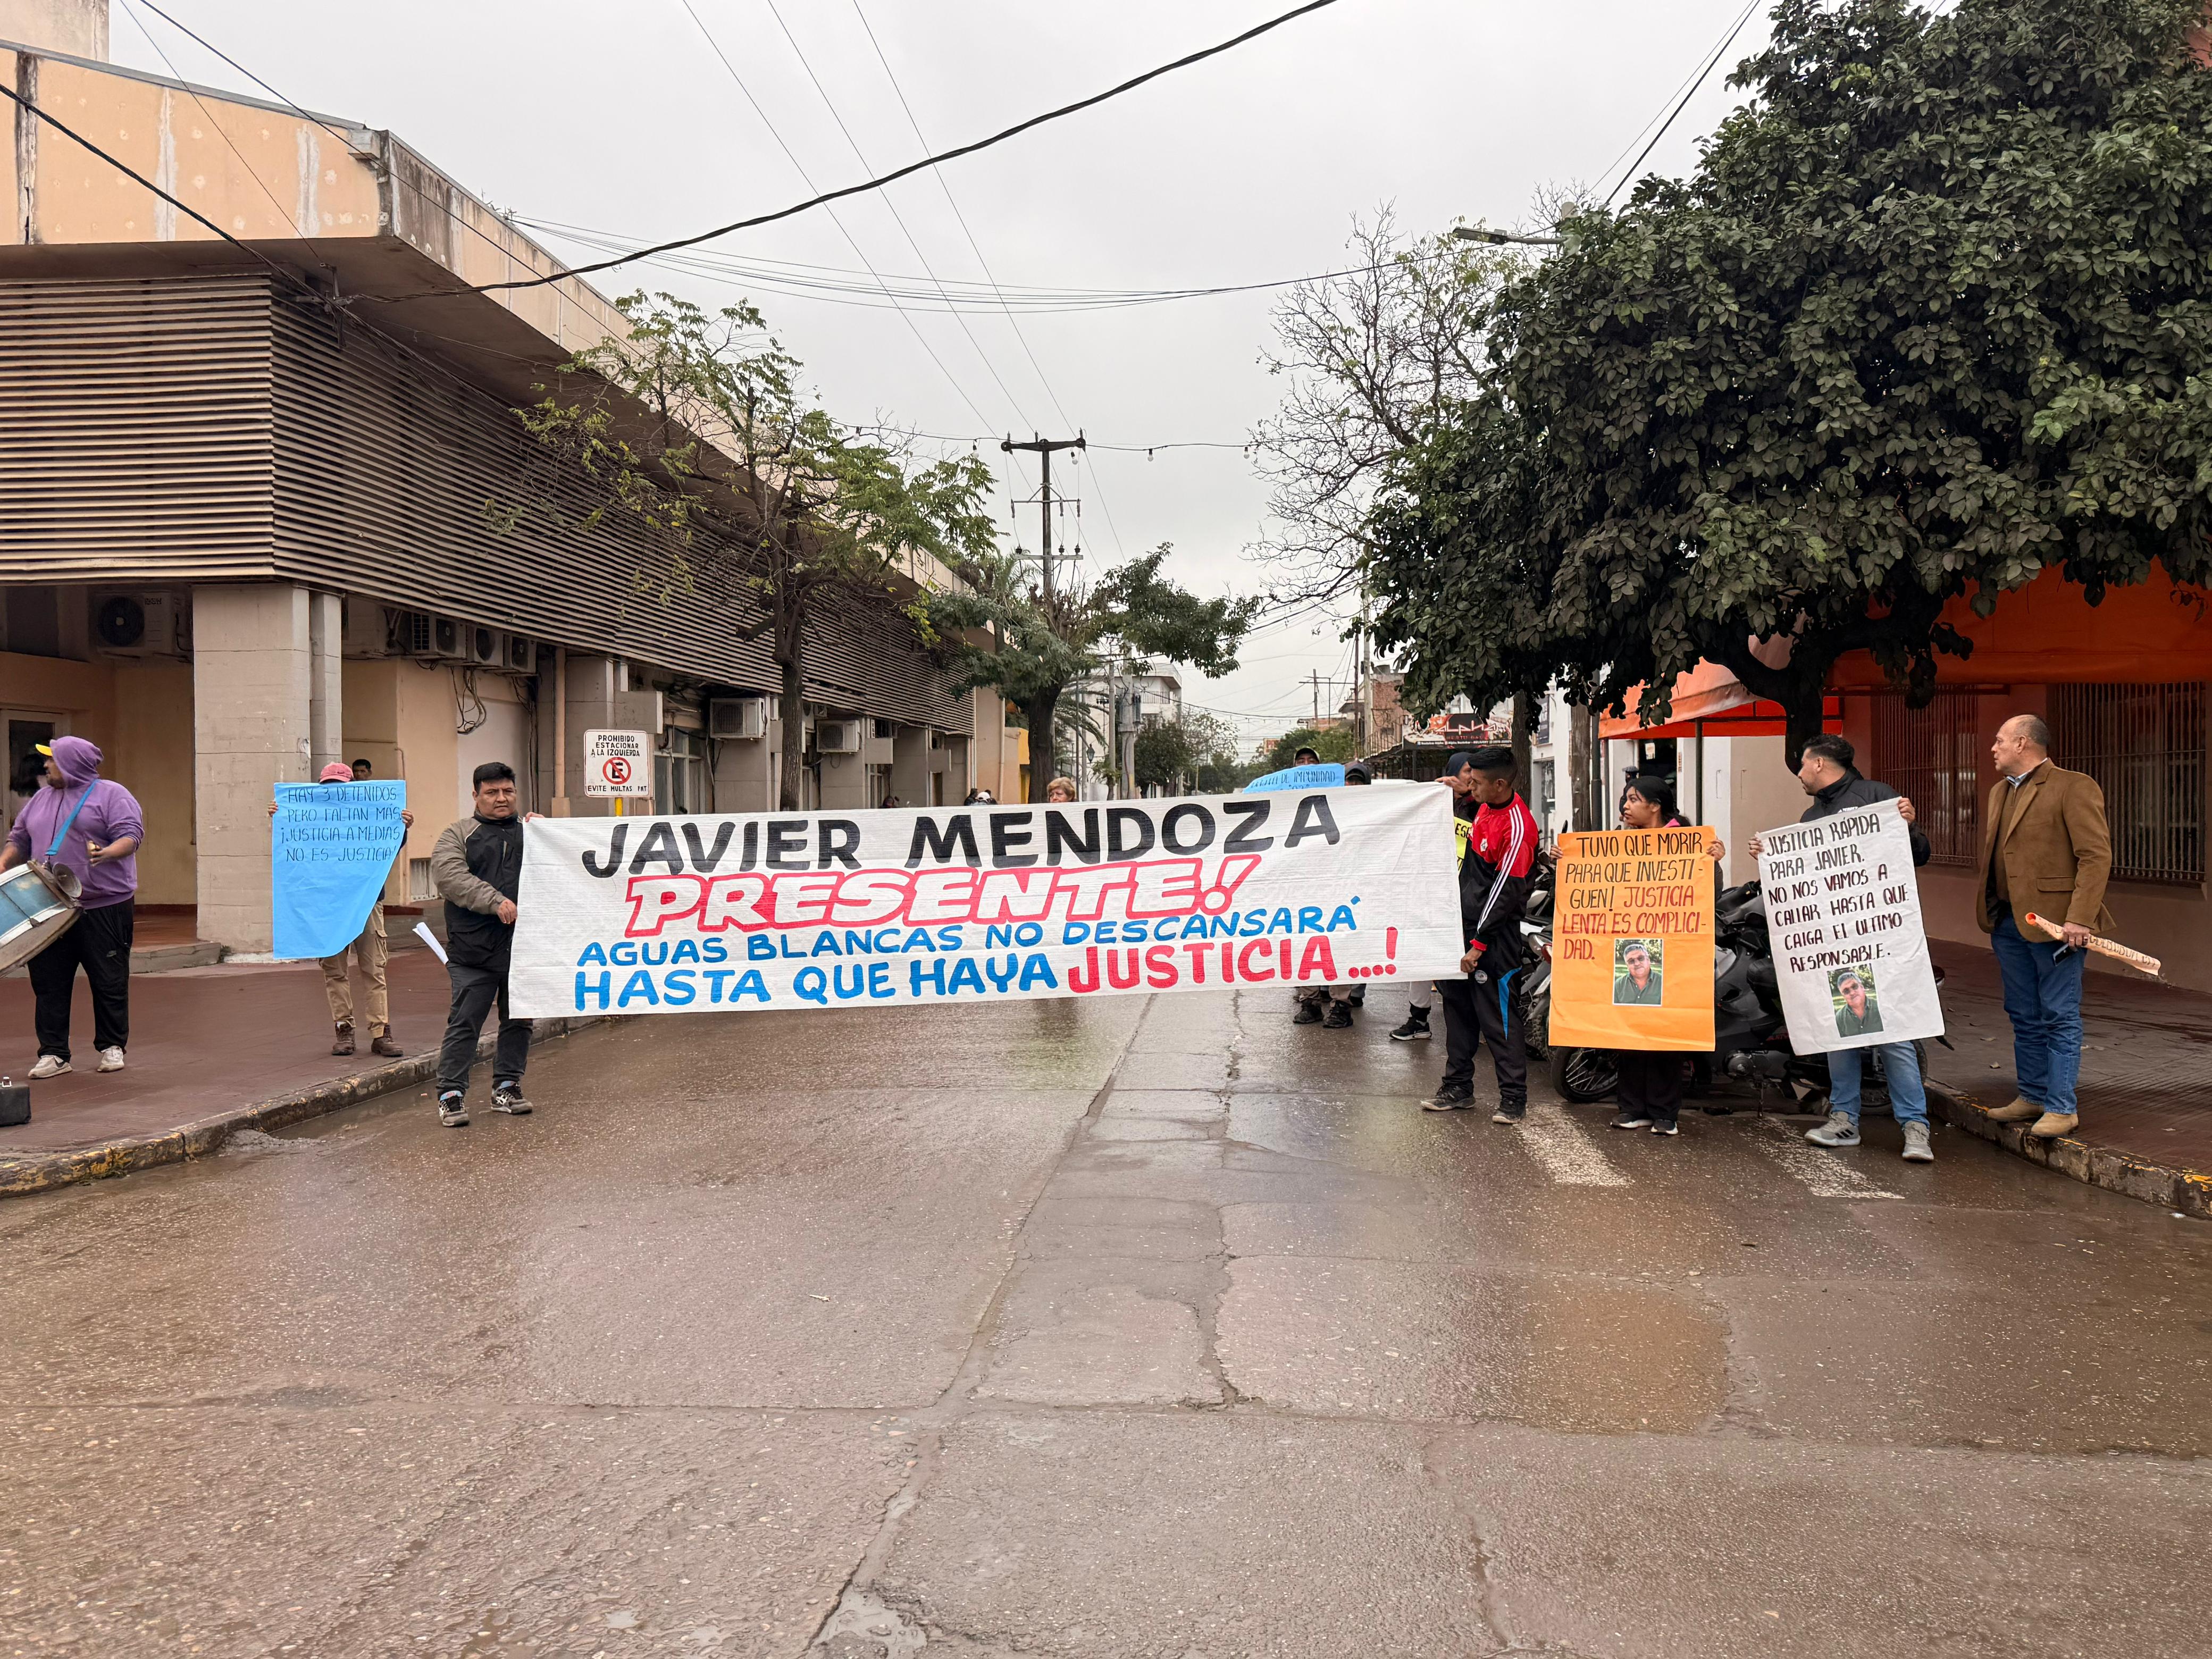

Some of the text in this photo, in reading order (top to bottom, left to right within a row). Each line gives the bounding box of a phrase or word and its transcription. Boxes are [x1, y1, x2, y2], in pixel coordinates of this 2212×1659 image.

[288, 786, 397, 803] HAY 3 DETENIDOS
[325, 807, 368, 822] FALTAN
[346, 827, 354, 841] A
[358, 826, 400, 842] MEDIAS
[582, 794, 1340, 878] JAVIER MENDOZA
[1576, 832, 1703, 858] TUVO QUE MORIR
[1766, 813, 1881, 857] JUSTICIA RÁPIDA
[286, 848, 304, 862] NO
[312, 848, 329, 861] ES
[1769, 843, 1865, 881] PARA JAVIER.
[1565, 863, 1602, 883] PARA
[1604, 862, 1632, 883] QUE
[1768, 864, 1888, 906] NO NOS VAMOS A
[624, 854, 1261, 938] PRESENTE!
[1570, 885, 1695, 911] GUEN! JUSTICIA
[1775, 883, 1909, 927] CALLAR HASTA QUE
[577, 895, 1361, 967] AGUAS BLANCAS NO DESCANSARÁ
[1562, 913, 1606, 934] LENTA
[1611, 913, 1631, 934] ES
[1784, 912, 1903, 950] CAIGA EL ULTIMO
[1563, 939, 1596, 960] DAD.
[1790, 943, 1891, 973] RESPONSABLE.
[575, 969, 772, 1011] HASTA
[793, 962, 896, 1005] QUE
[909, 952, 1058, 996] HAYA
